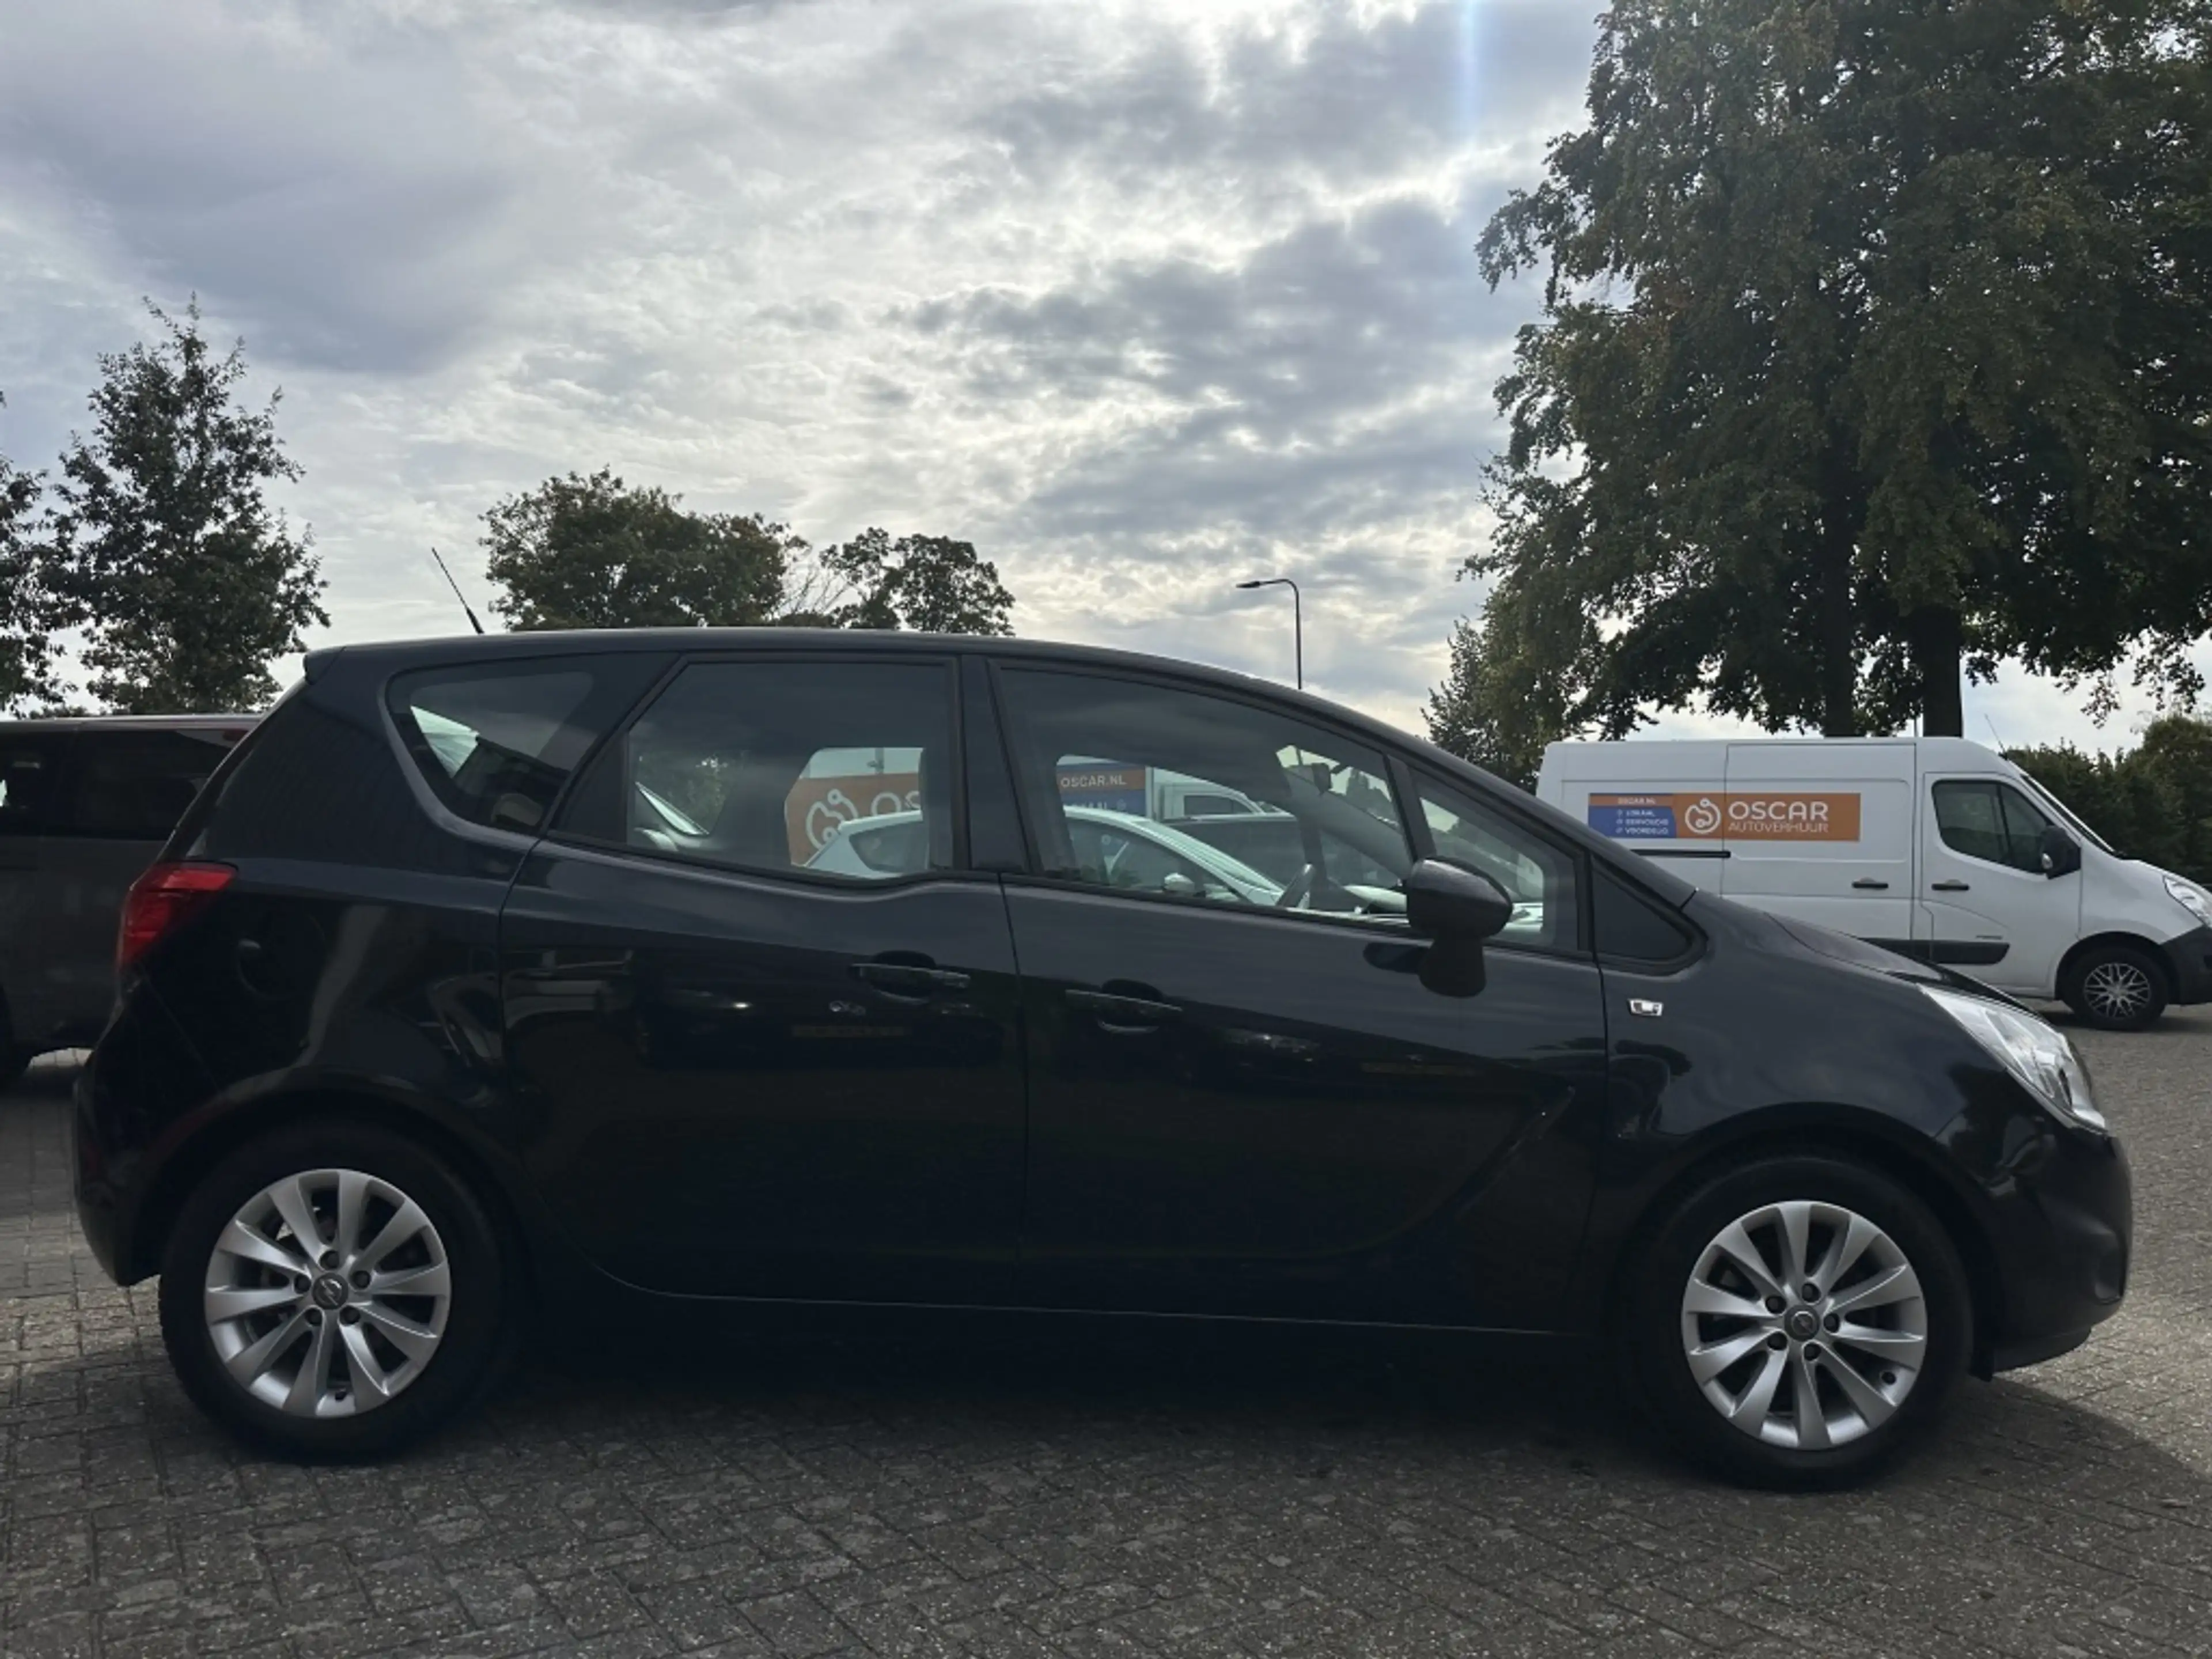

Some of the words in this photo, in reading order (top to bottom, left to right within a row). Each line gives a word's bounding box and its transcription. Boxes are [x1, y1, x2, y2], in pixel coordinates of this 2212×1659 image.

[1060, 775, 1127, 788] OSCAR.NL
[1729, 801, 1828, 821] OSCAR
[1729, 821, 1829, 833] AUTOVERHUUR
